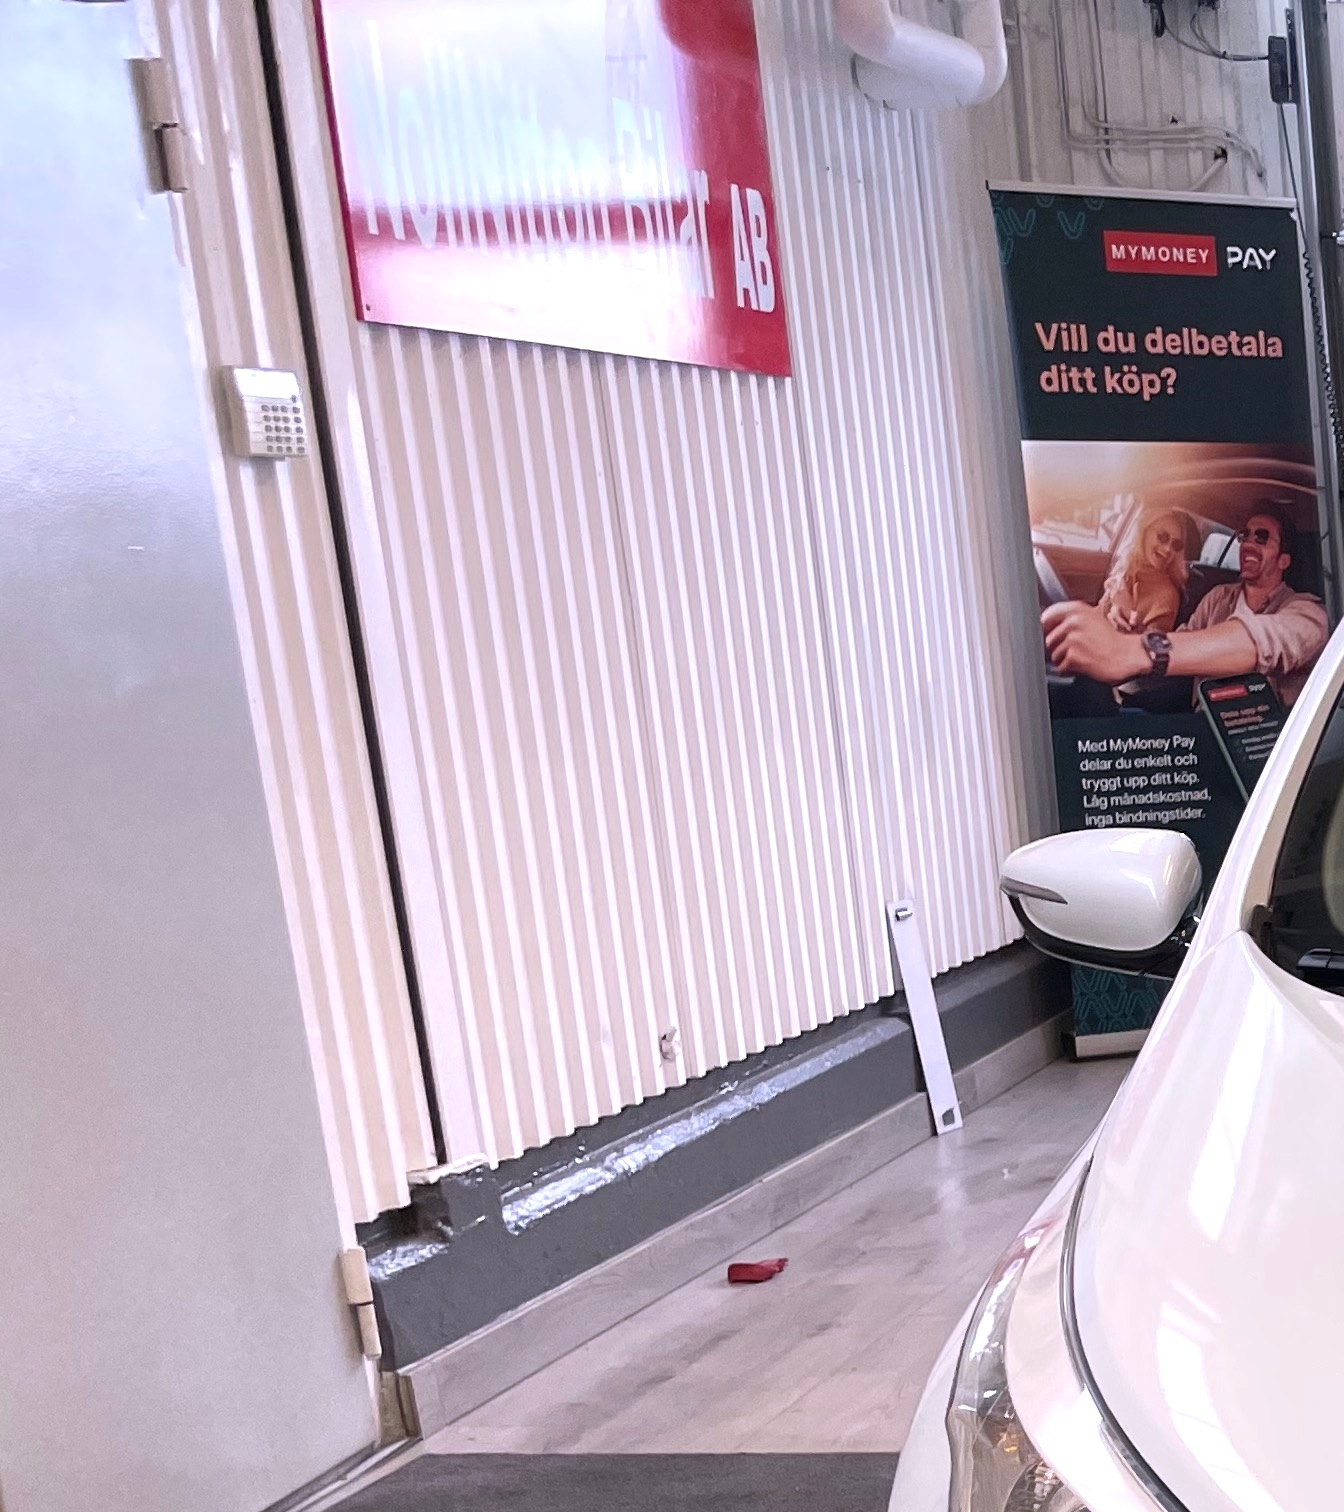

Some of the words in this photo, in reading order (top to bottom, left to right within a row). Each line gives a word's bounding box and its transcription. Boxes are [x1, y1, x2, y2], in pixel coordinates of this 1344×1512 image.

[729, 183, 775, 313] AB
[1110, 243, 1210, 265] MYMONEY
[1226, 245, 1277, 271] PAY
[1034, 321, 1089, 352] Vill
[1096, 324, 1136, 354] du
[1144, 326, 1284, 358] delbetala
[1039, 363, 1098, 393] ditt
[1104, 365, 1178, 402] köp?
[1078, 737, 1108, 753] Med
[1109, 736, 1171, 754] MyMoney
[1173, 734, 1197, 750] Pay
[1079, 757, 1113, 772] delar
[1115, 755, 1132, 770] du
[1134, 753, 1173, 769] enkelt
[1174, 752, 1198, 767] och
[1081, 775, 1122, 793] tryggt
[1124, 776, 1149, 790] upp
[1150, 772, 1172, 786] ditt
[1174, 770, 1200, 787] köp.
[1083, 793, 1109, 811] Låg
[1110, 787, 1212, 808] månadskostnad,
[1115, 806, 1206, 826] bindningstider.
